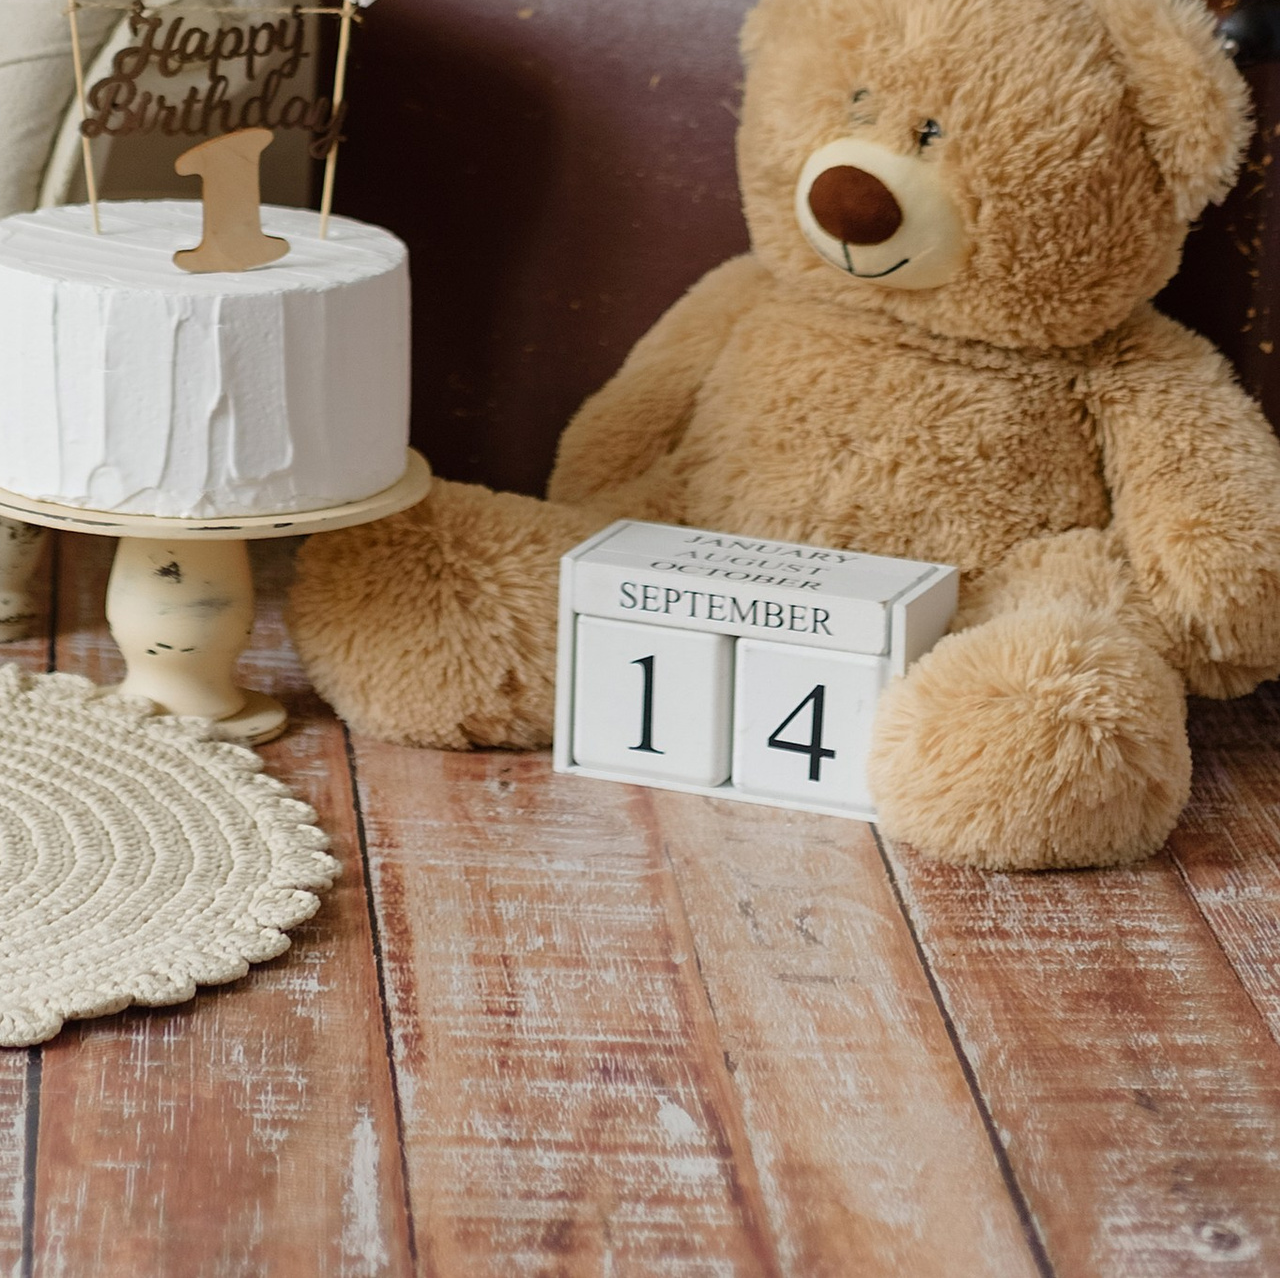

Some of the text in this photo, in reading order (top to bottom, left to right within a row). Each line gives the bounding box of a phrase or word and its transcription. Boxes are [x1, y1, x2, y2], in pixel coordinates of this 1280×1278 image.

[112, 3, 309, 80] Happy
[80, 69, 348, 159] Birthday
[172, 128, 290, 273] 1
[649, 560, 823, 592] OCTOBER
[675, 550, 832, 577] AUGUST
[685, 534, 859, 565] JANUARY
[619, 581, 833, 636] SEPTEMBER
